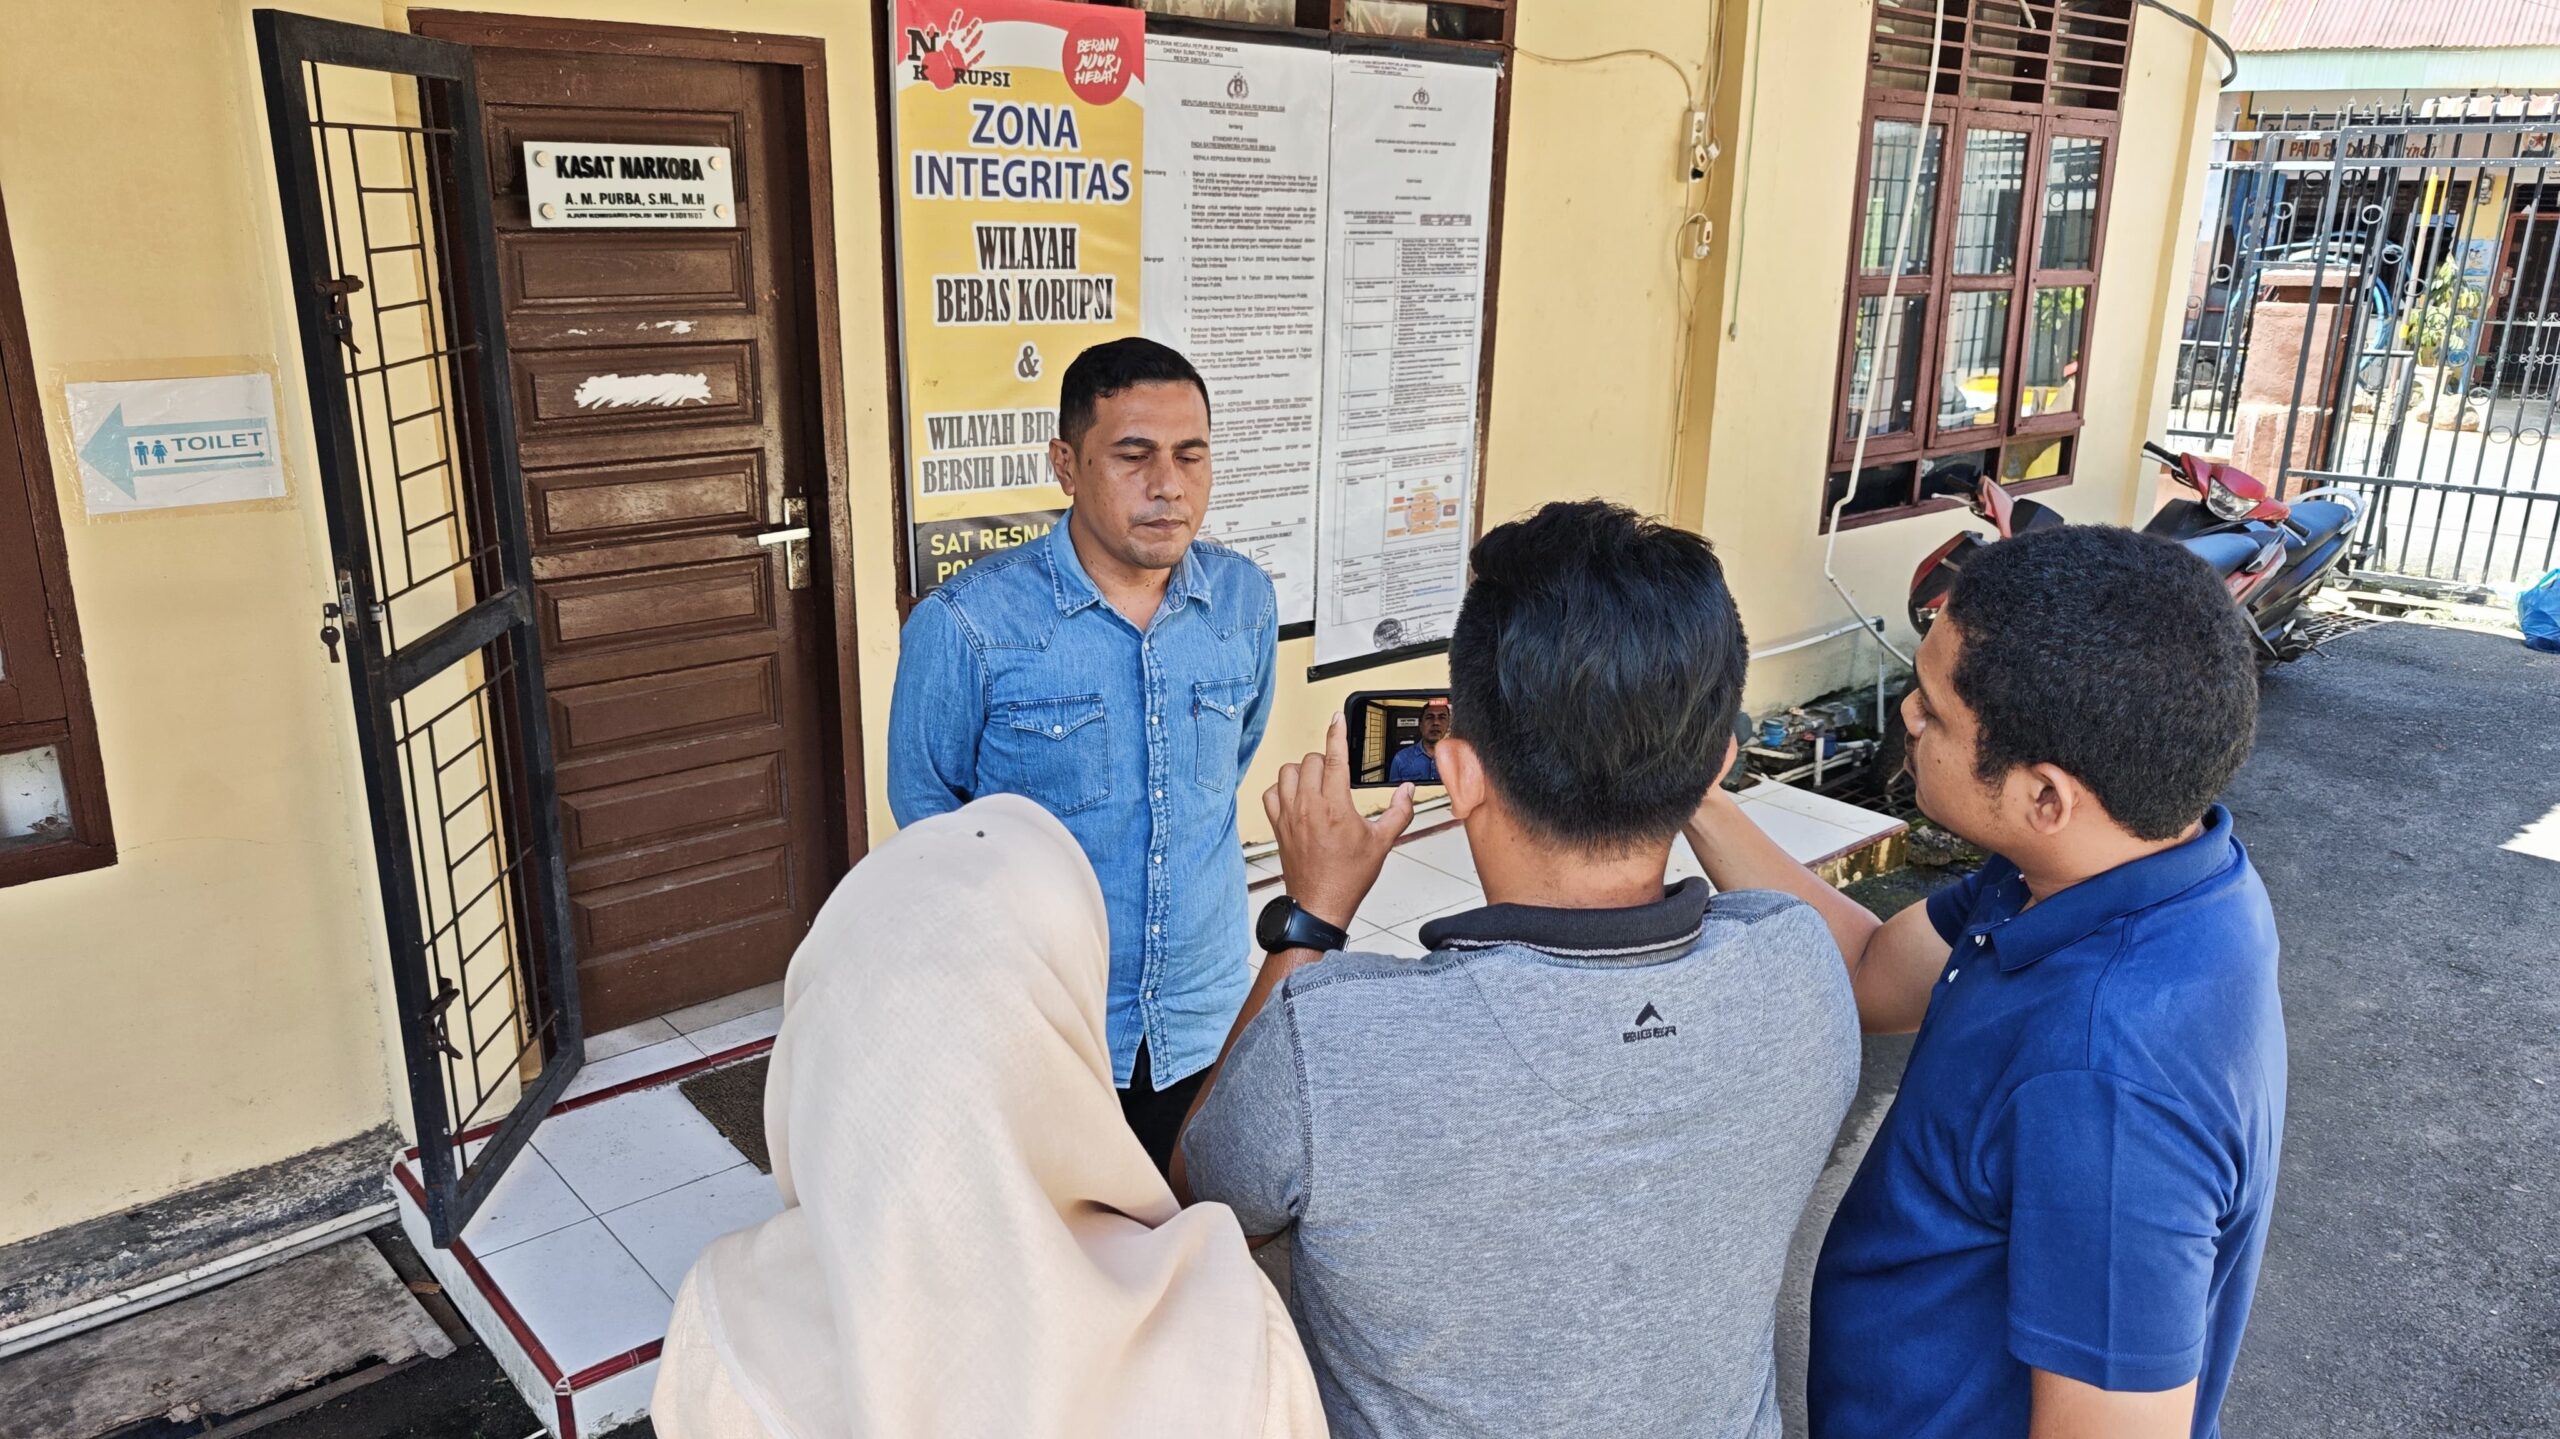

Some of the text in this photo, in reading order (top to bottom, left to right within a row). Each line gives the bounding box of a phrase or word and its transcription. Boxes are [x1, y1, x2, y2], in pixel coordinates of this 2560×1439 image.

[1077, 36, 1119, 54] BERANI
[972, 103, 1078, 148] ZONA
[555, 155, 704, 181] KASAT NARKOBA
[915, 155, 1130, 201] INTEGRITAS
[565, 192, 578, 205] A.
[580, 192, 597, 205] M.
[599, 192, 645, 207] PURBA,
[976, 226, 1076, 270] WILAYAH
[936, 278, 1114, 322] BEBAS KORUPSI
[1018, 345, 1040, 378] &
[171, 432, 263, 452] TOILET
[928, 413, 1015, 450] WILAYAH
[922, 456, 995, 493] BERSIH
[1001, 453, 1038, 487] DAN
[930, 530, 973, 556] SAT
